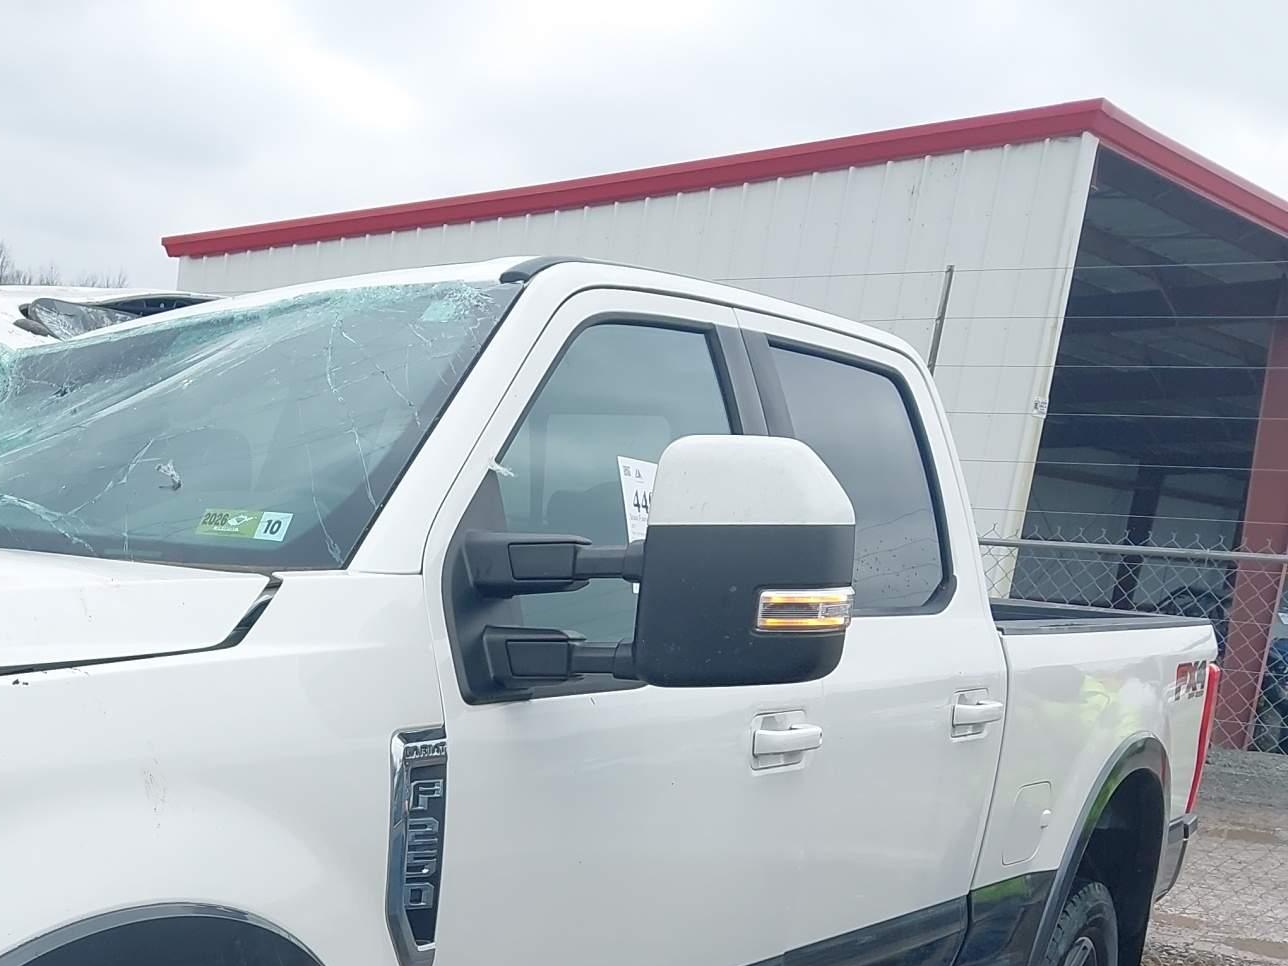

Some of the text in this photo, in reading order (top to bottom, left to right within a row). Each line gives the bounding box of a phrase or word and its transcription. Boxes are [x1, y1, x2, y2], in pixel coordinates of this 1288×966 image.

[632, 489, 653, 514] 44
[202, 512, 230, 527] 2026
[263, 519, 282, 535] 10
